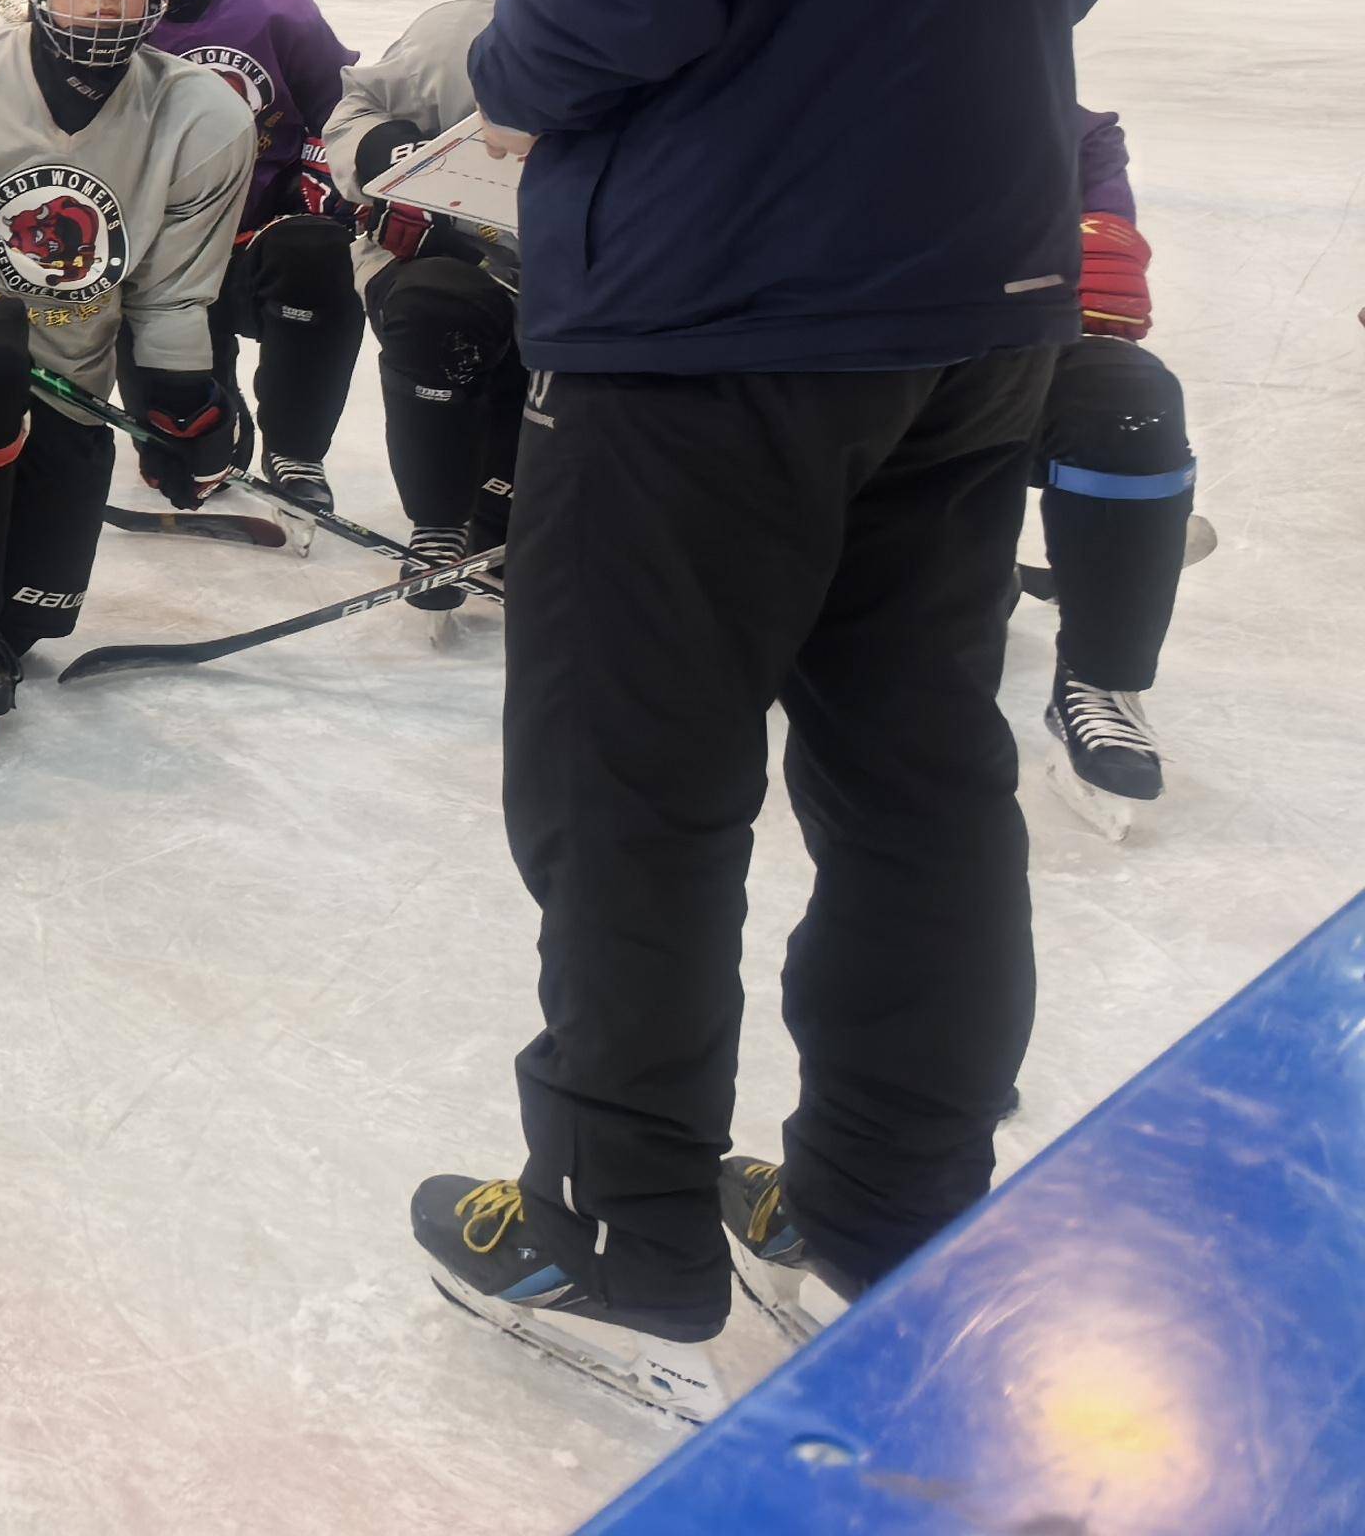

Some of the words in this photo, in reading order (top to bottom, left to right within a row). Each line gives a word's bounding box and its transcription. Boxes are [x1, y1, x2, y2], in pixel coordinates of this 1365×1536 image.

[51, 170, 121, 231] WOMEN'S
[69, 277, 112, 301] CLUB
[342, 561, 489, 617] BAUER
[646, 1358, 709, 1391] TRUE
